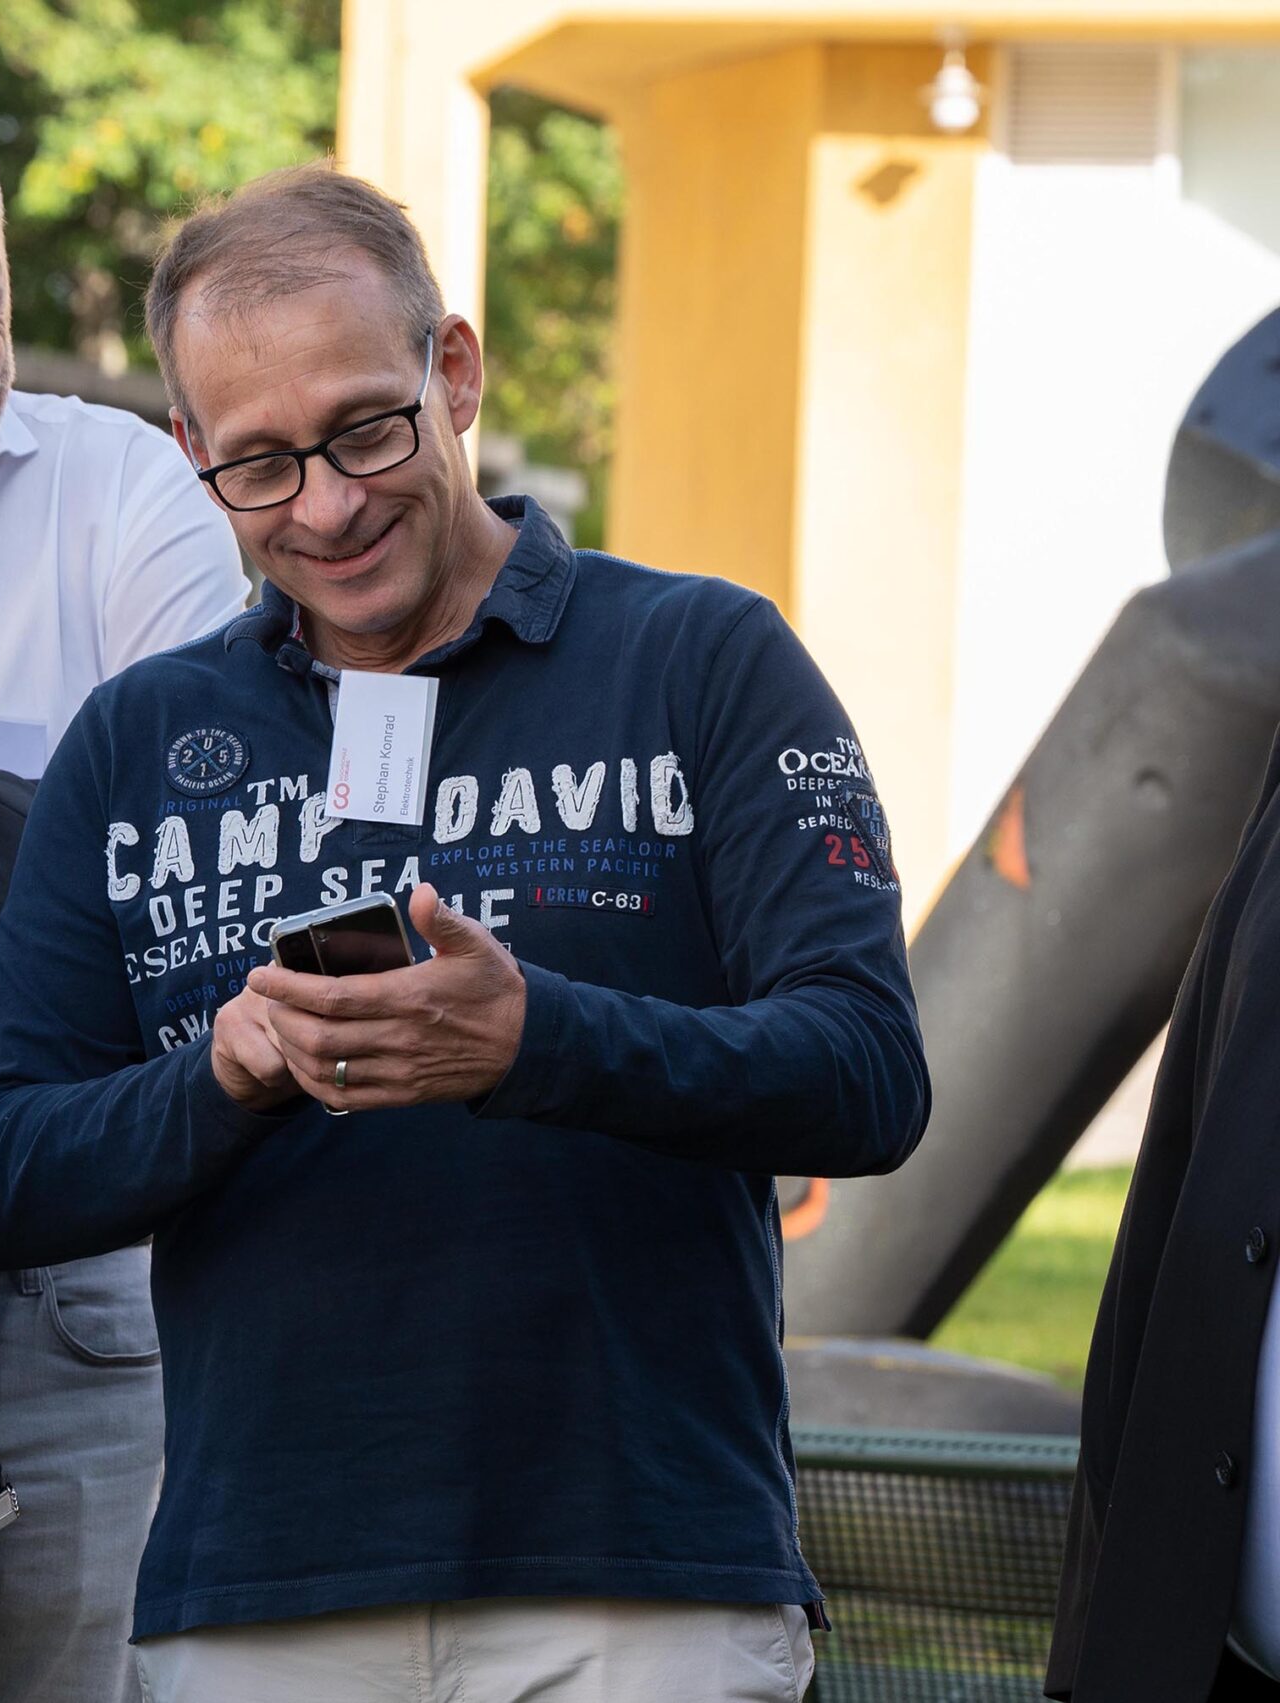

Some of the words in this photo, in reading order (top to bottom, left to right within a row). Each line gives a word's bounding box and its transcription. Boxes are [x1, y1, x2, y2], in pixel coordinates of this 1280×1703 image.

[172, 732, 193, 750] DOWN
[196, 728, 207, 736] TO
[210, 728, 226, 738] THE
[380, 714, 396, 759] Konrad
[182, 749, 193, 763] 2
[219, 749, 228, 763] 5
[227, 734, 243, 765] SEAFLOOR
[168, 752, 177, 769] DIVE
[200, 762, 207, 776] 1
[174, 773, 206, 789] PACIFIC
[208, 771, 236, 788] OCEAN
[247, 774, 308, 806] TM
[373, 762, 390, 814] Stephan
[400, 756, 415, 816] Elektrotechnik
[787, 777, 851, 791] DEEPE
[816, 795, 832, 808] IN
[105, 791, 345, 901] CAMP
[433, 751, 694, 844] DAVID
[430, 843, 515, 866] EXPLORE
[529, 838, 567, 855] THE
[580, 837, 676, 859] SEAFLOOR
[475, 858, 574, 878] WESTERN
[587, 858, 660, 877] PACIFIC
[149, 874, 282, 937] DEEP
[320, 856, 420, 906] SEA
[546, 887, 589, 903] CREW
[591, 891, 642, 910] C-63
[125, 914, 298, 984] ESEARC
[166, 984, 218, 1012] DEEPER
